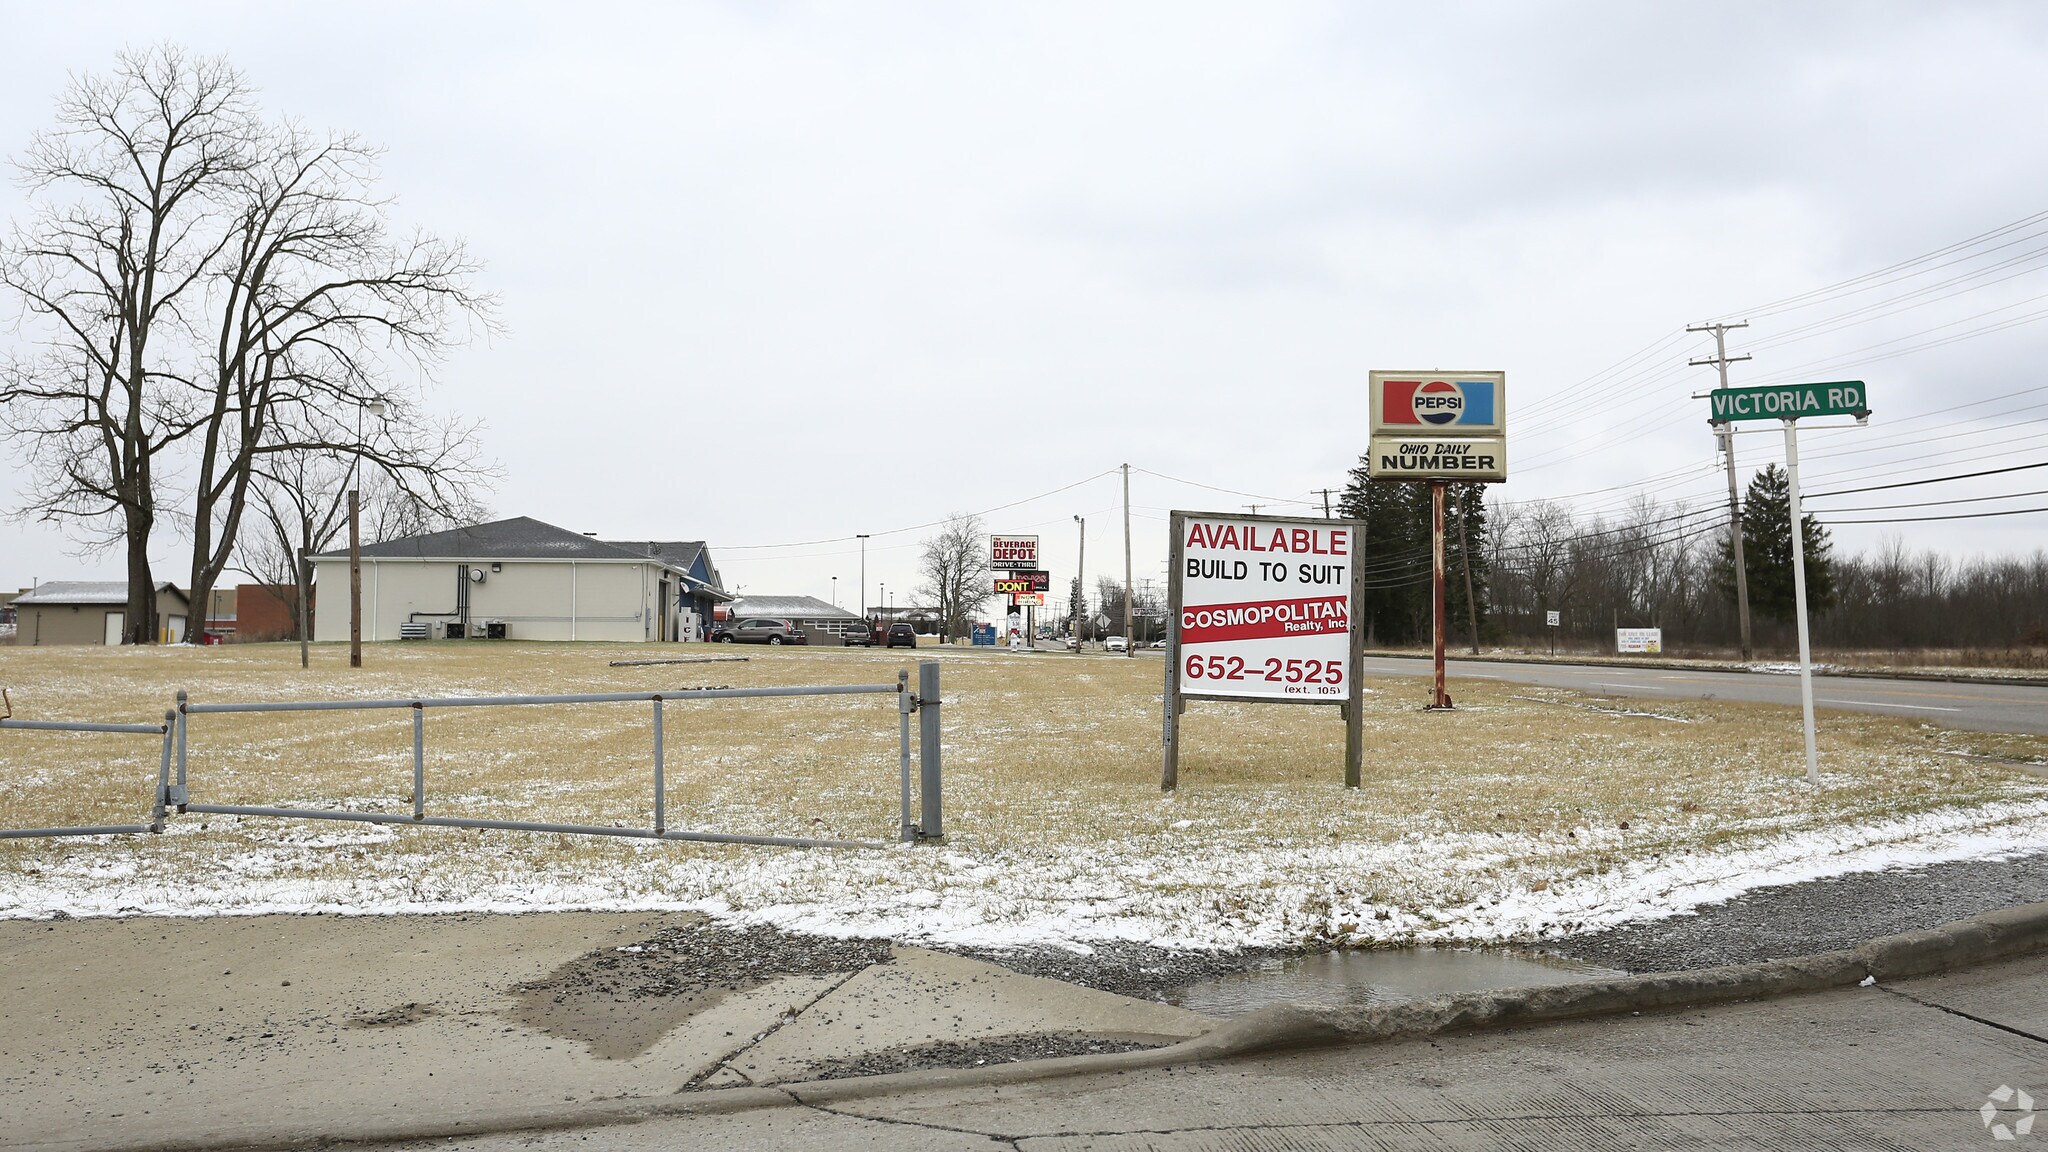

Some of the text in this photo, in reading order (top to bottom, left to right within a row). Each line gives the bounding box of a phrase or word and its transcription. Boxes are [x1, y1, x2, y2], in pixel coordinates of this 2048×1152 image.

[1415, 397, 1461, 408] PEPSI
[1714, 387, 1863, 415] VICTORIA RD.
[1400, 444, 1471, 455] OHIO DAILY
[1382, 456, 1495, 469] NUMBER
[1186, 524, 1347, 555] AVAILABLE
[993, 548, 1035, 559] DEPOT
[1187, 558, 1345, 584] BUILD TO SUIT
[997, 582, 1029, 591] DONT
[1182, 600, 1348, 629] COSMOPOLITAN
[1284, 621, 1324, 633] Realty,
[1186, 654, 1343, 685] 652-2525
[1284, 685, 1341, 695] (ext. 105)
